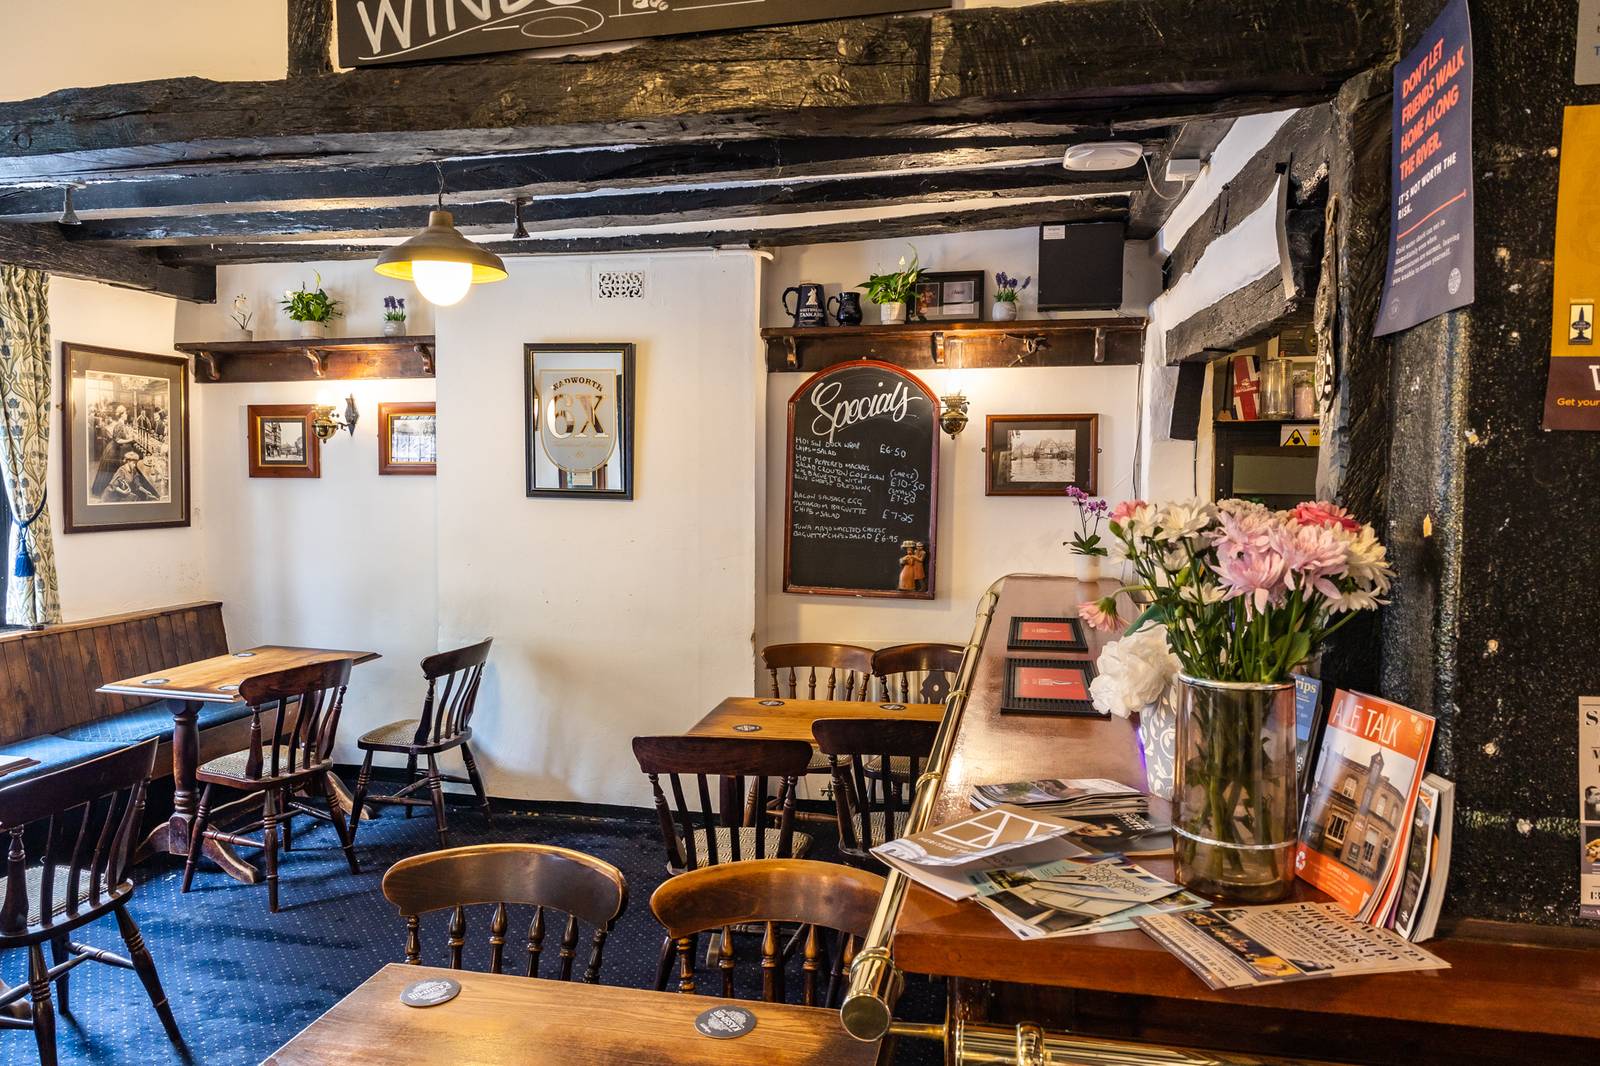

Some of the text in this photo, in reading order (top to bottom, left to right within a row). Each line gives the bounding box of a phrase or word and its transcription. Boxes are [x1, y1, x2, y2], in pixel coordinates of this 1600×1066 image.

[1402, 38, 1444, 99] DON'T LET
[1402, 46, 1465, 127] FRIENDS WALK
[1401, 84, 1459, 154] HOME ALONG
[1400, 131, 1442, 181] THE RIVER.
[1398, 152, 1457, 206] IT'S NOT WORTH THE
[1397, 203, 1413, 220] RISK.
[552, 376, 603, 393] WADWORTH
[1557, 398, 1600, 408] Get your
[547, 394, 609, 439] 6X
[811, 381, 923, 444] Specials
[796, 454, 811, 463] HOT
[793, 523, 812, 531] TUNA
[814, 525, 832, 534] MAYO
[1363, 708, 1402, 748] TALK
